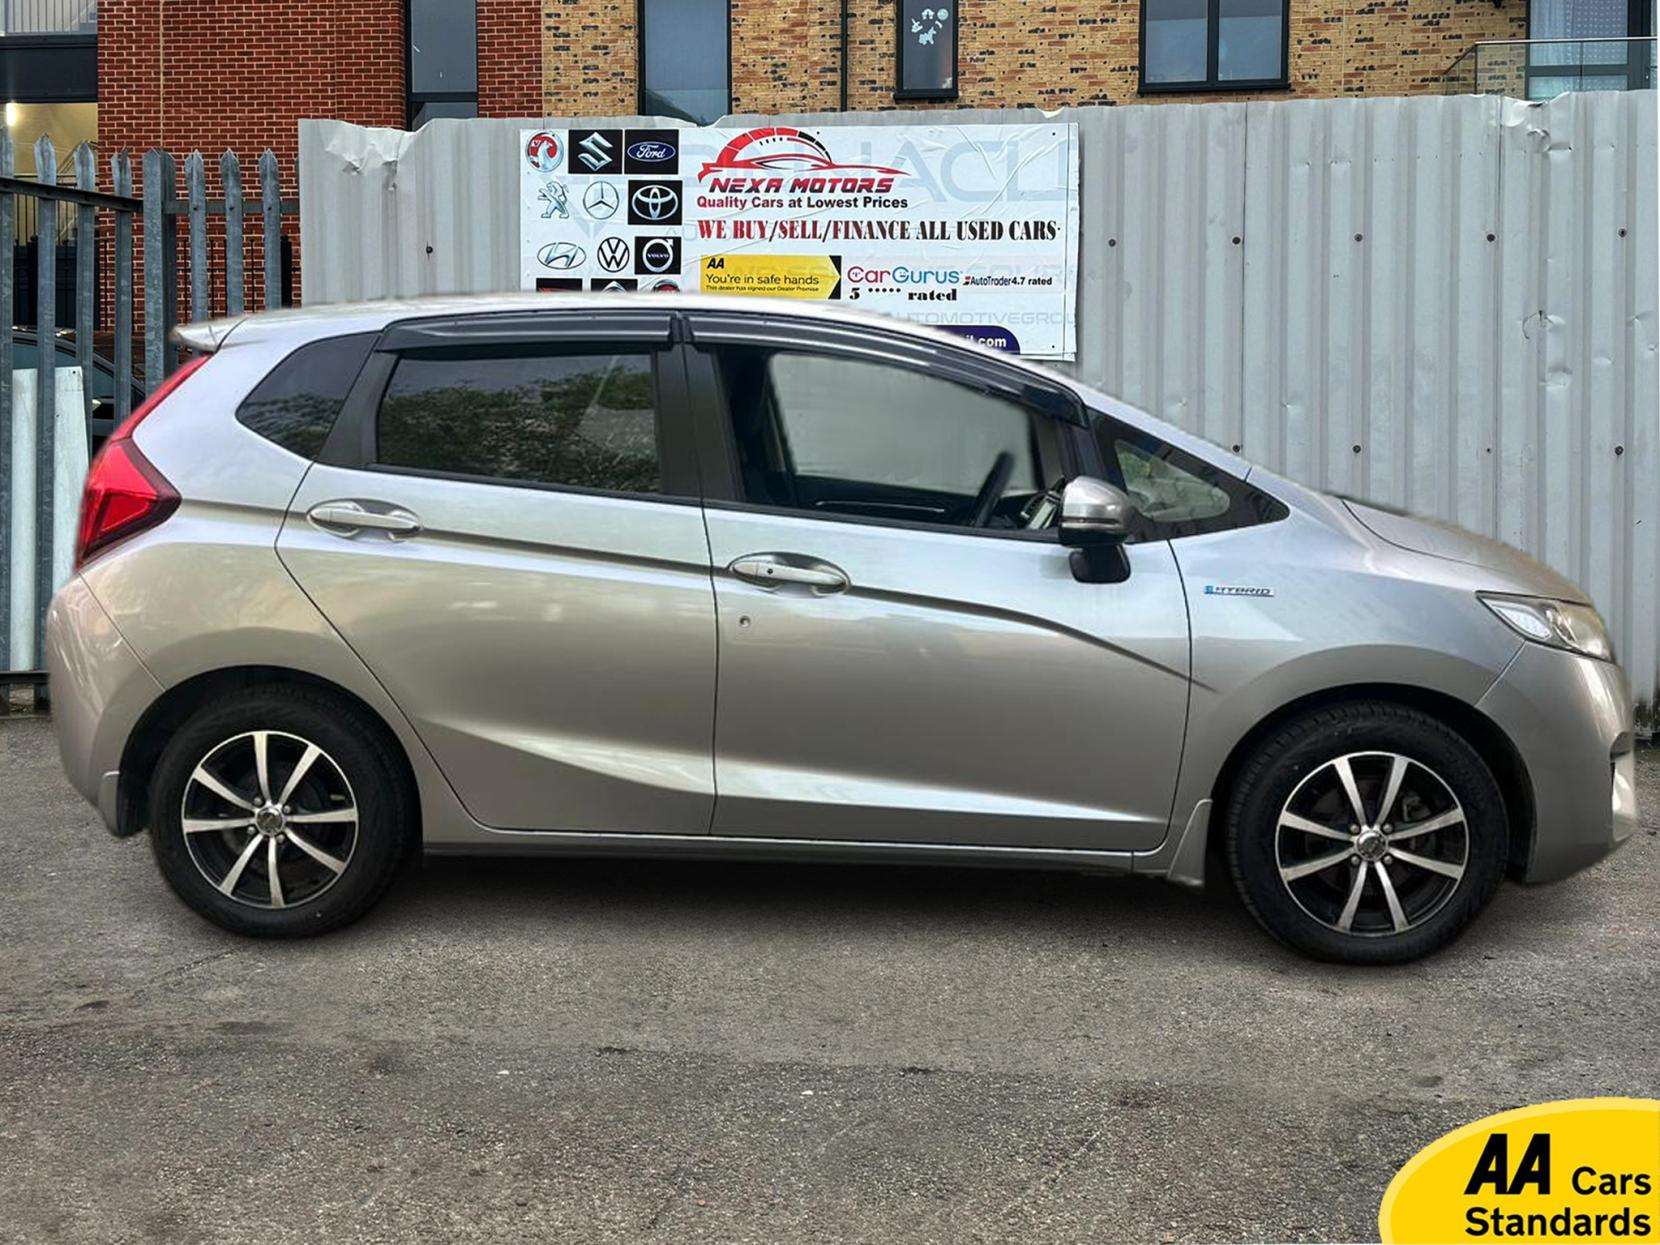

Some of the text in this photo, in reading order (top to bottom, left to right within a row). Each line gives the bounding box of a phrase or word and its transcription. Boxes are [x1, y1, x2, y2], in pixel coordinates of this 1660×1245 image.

[636, 144, 666, 159] Ford
[709, 178, 894, 193] NEXA MOTORS
[697, 196, 908, 210] Quality Cars at Lowest Prices
[698, 220, 727, 240] WE
[915, 220, 950, 240] ALL
[956, 220, 1003, 241] USED
[1009, 220, 1057, 240] CARS
[706, 258, 725, 269] AA
[706, 273, 819, 285] You're in safe hands
[847, 266, 960, 284] CarGurus
[1028, 276, 1053, 286] rated
[849, 287, 958, 301] 5 rated
[1215, 586, 1271, 595] HYBRID
